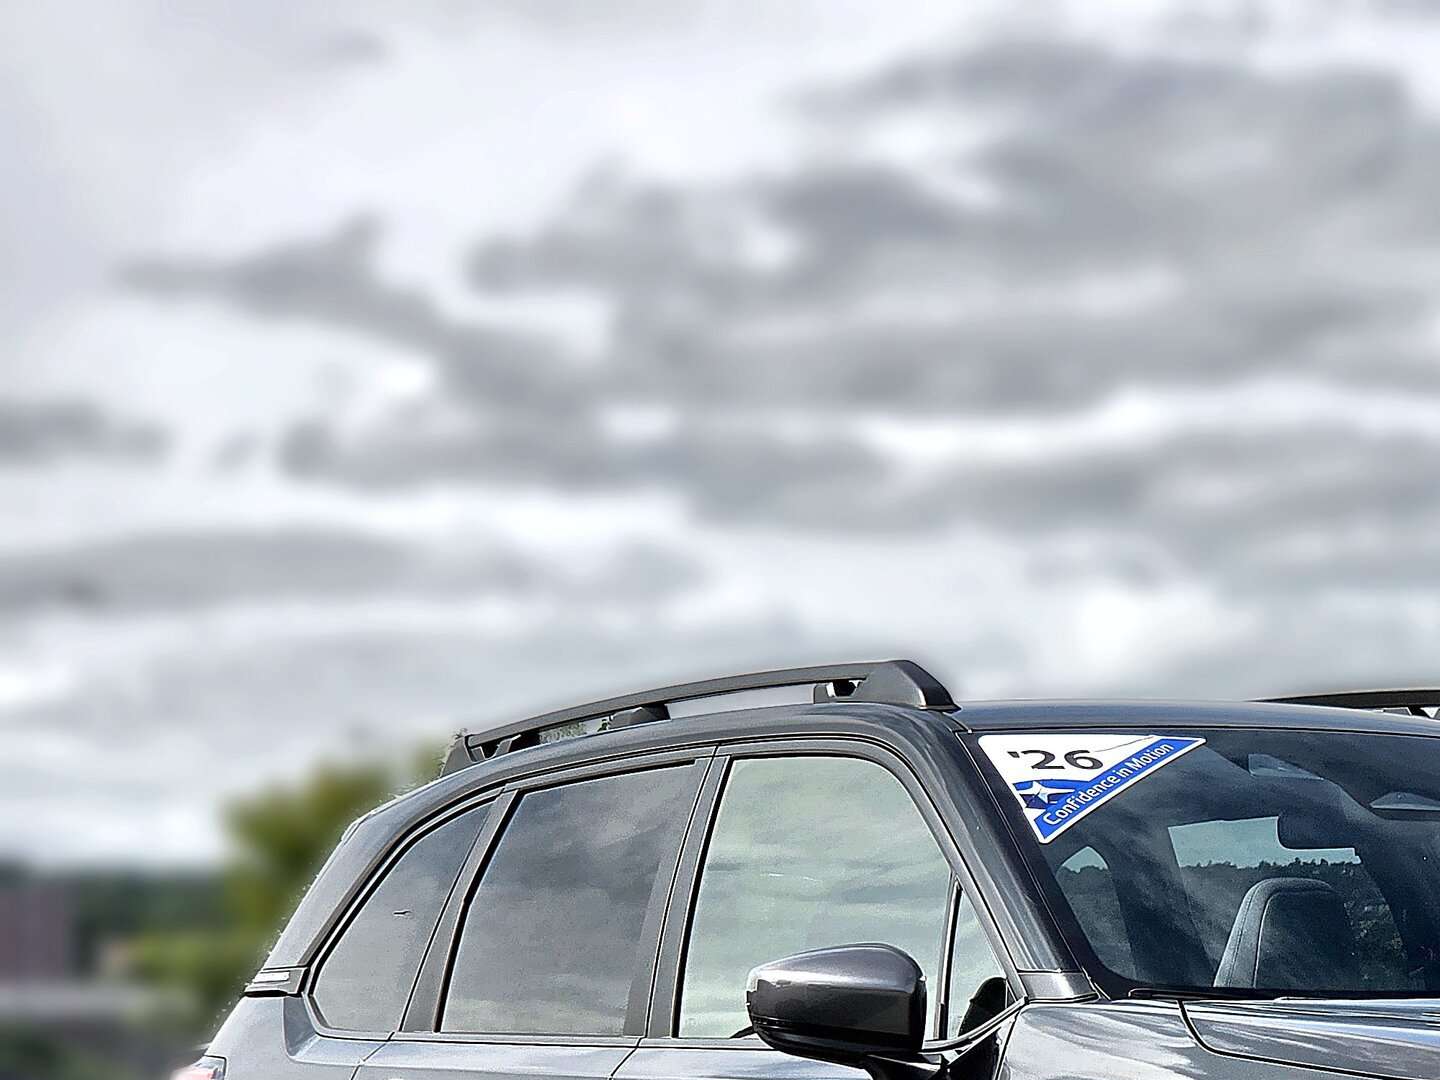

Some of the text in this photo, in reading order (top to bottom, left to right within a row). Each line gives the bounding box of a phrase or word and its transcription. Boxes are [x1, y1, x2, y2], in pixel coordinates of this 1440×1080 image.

[1043, 742, 1174, 825] Confidence in Motion
